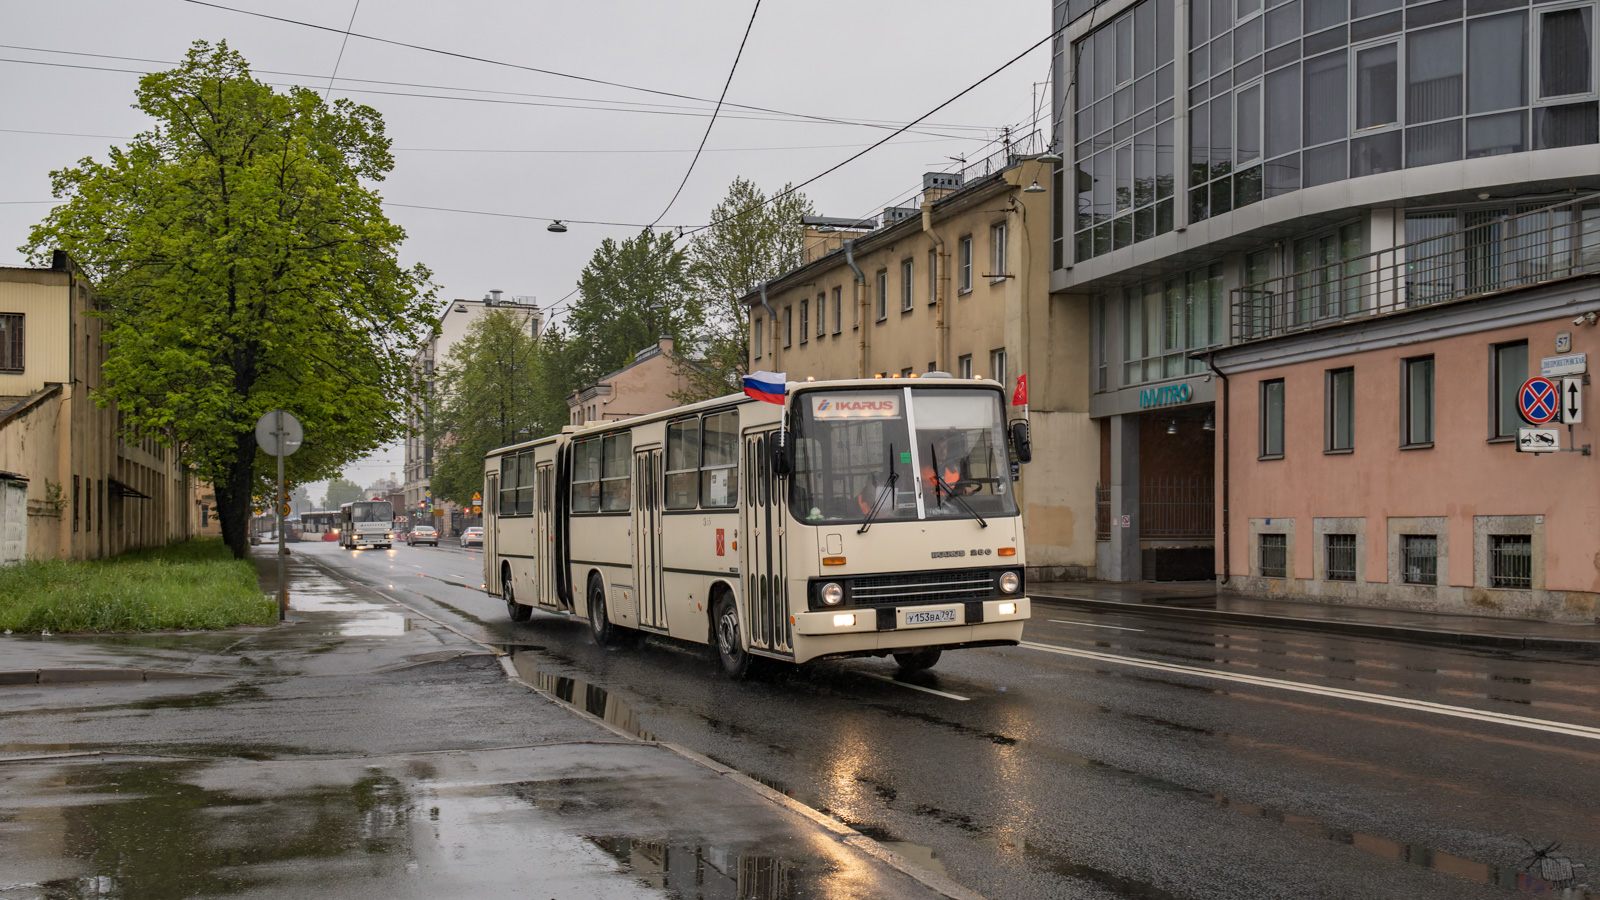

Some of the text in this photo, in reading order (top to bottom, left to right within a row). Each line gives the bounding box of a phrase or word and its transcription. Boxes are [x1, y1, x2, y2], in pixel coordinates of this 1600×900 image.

[1557, 336, 1568, 348] 57
[1139, 383, 1189, 408] INVITRO
[835, 400, 893, 411] IKARUS
[931, 550, 965, 559] IKARUS
